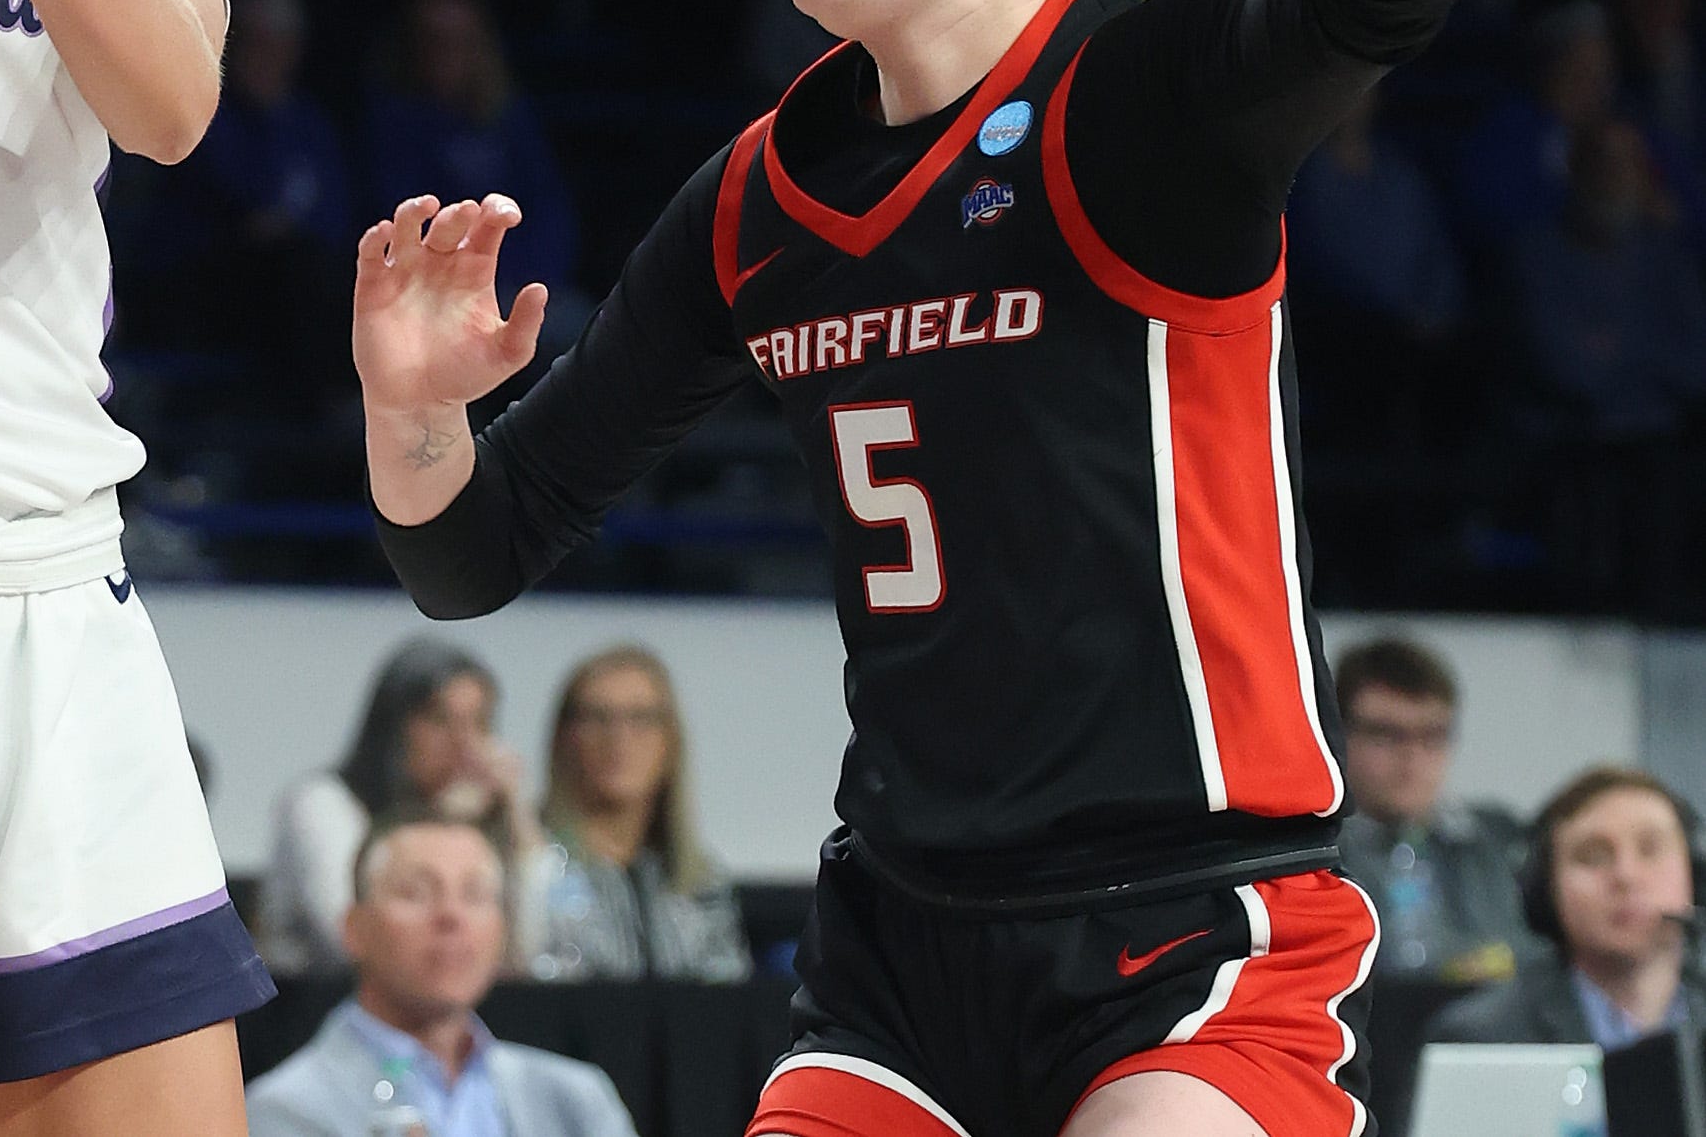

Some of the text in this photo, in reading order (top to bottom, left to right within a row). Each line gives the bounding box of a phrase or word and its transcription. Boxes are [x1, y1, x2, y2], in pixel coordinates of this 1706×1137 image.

[961, 183, 1014, 228] MAAC
[747, 287, 1044, 381] FAIRFIELD
[828, 400, 947, 614] 5
